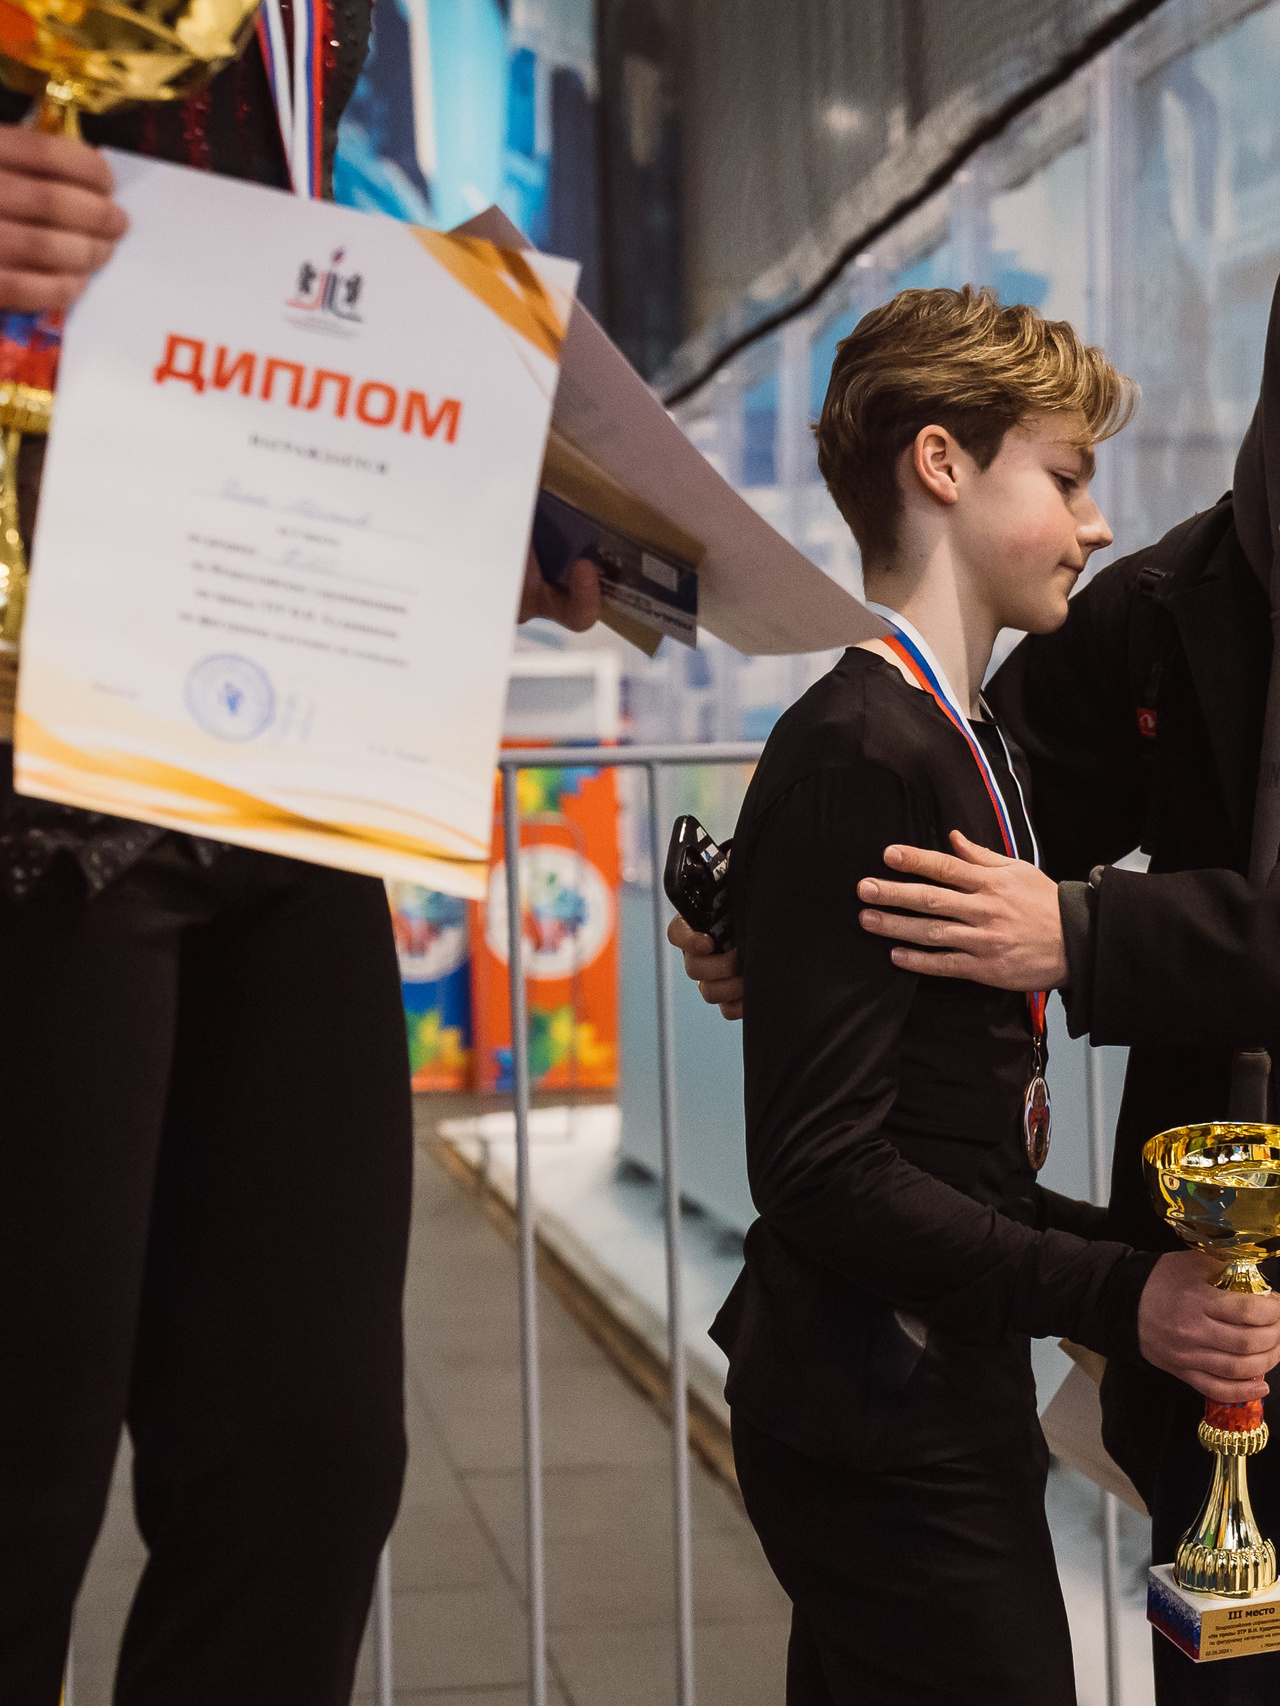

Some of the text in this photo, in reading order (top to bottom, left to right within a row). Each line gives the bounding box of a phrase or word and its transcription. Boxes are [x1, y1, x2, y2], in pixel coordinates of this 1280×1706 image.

[153, 333, 463, 445] ДИПЛОМ
[1228, 1607, 1275, 1620] III место
